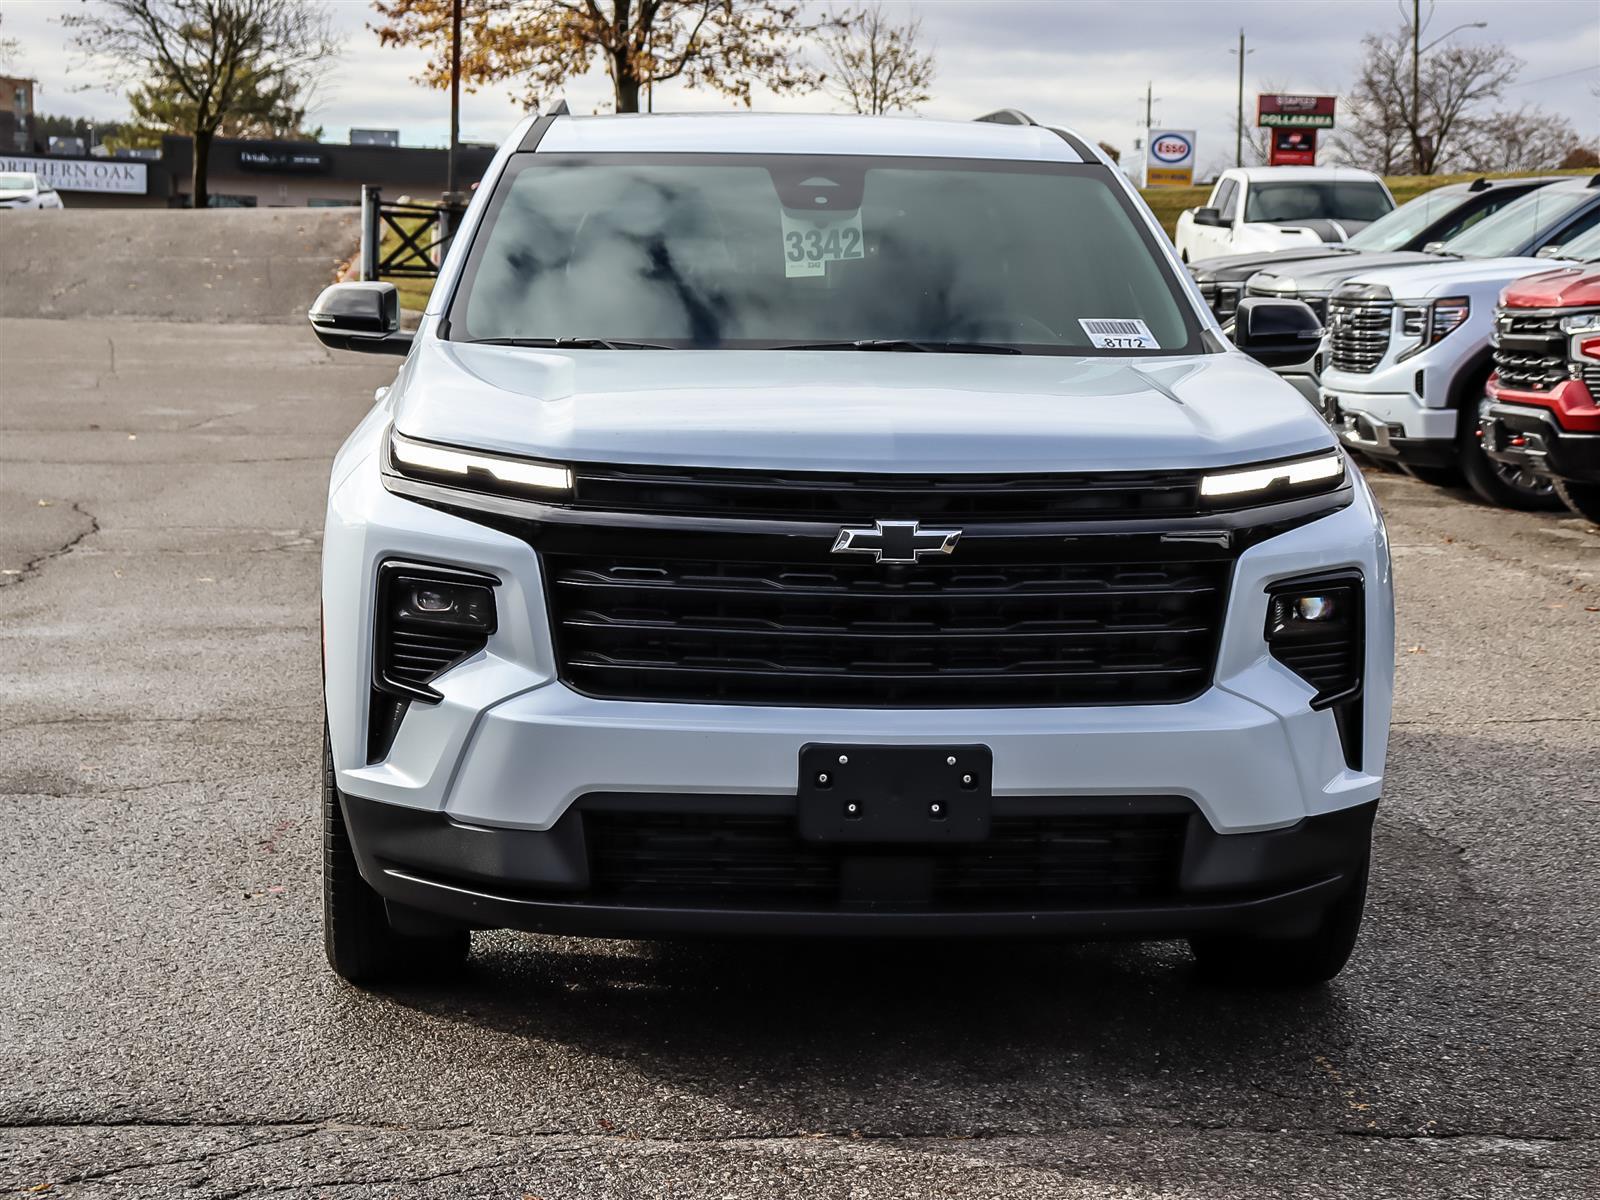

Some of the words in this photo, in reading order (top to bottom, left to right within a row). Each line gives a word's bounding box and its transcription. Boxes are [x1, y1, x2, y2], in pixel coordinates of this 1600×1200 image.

[1261, 114, 1332, 125] DOLLARAMA
[94, 165, 135, 180] OAK
[786, 227, 862, 262] 3342
[1104, 338, 1146, 348] 8772
